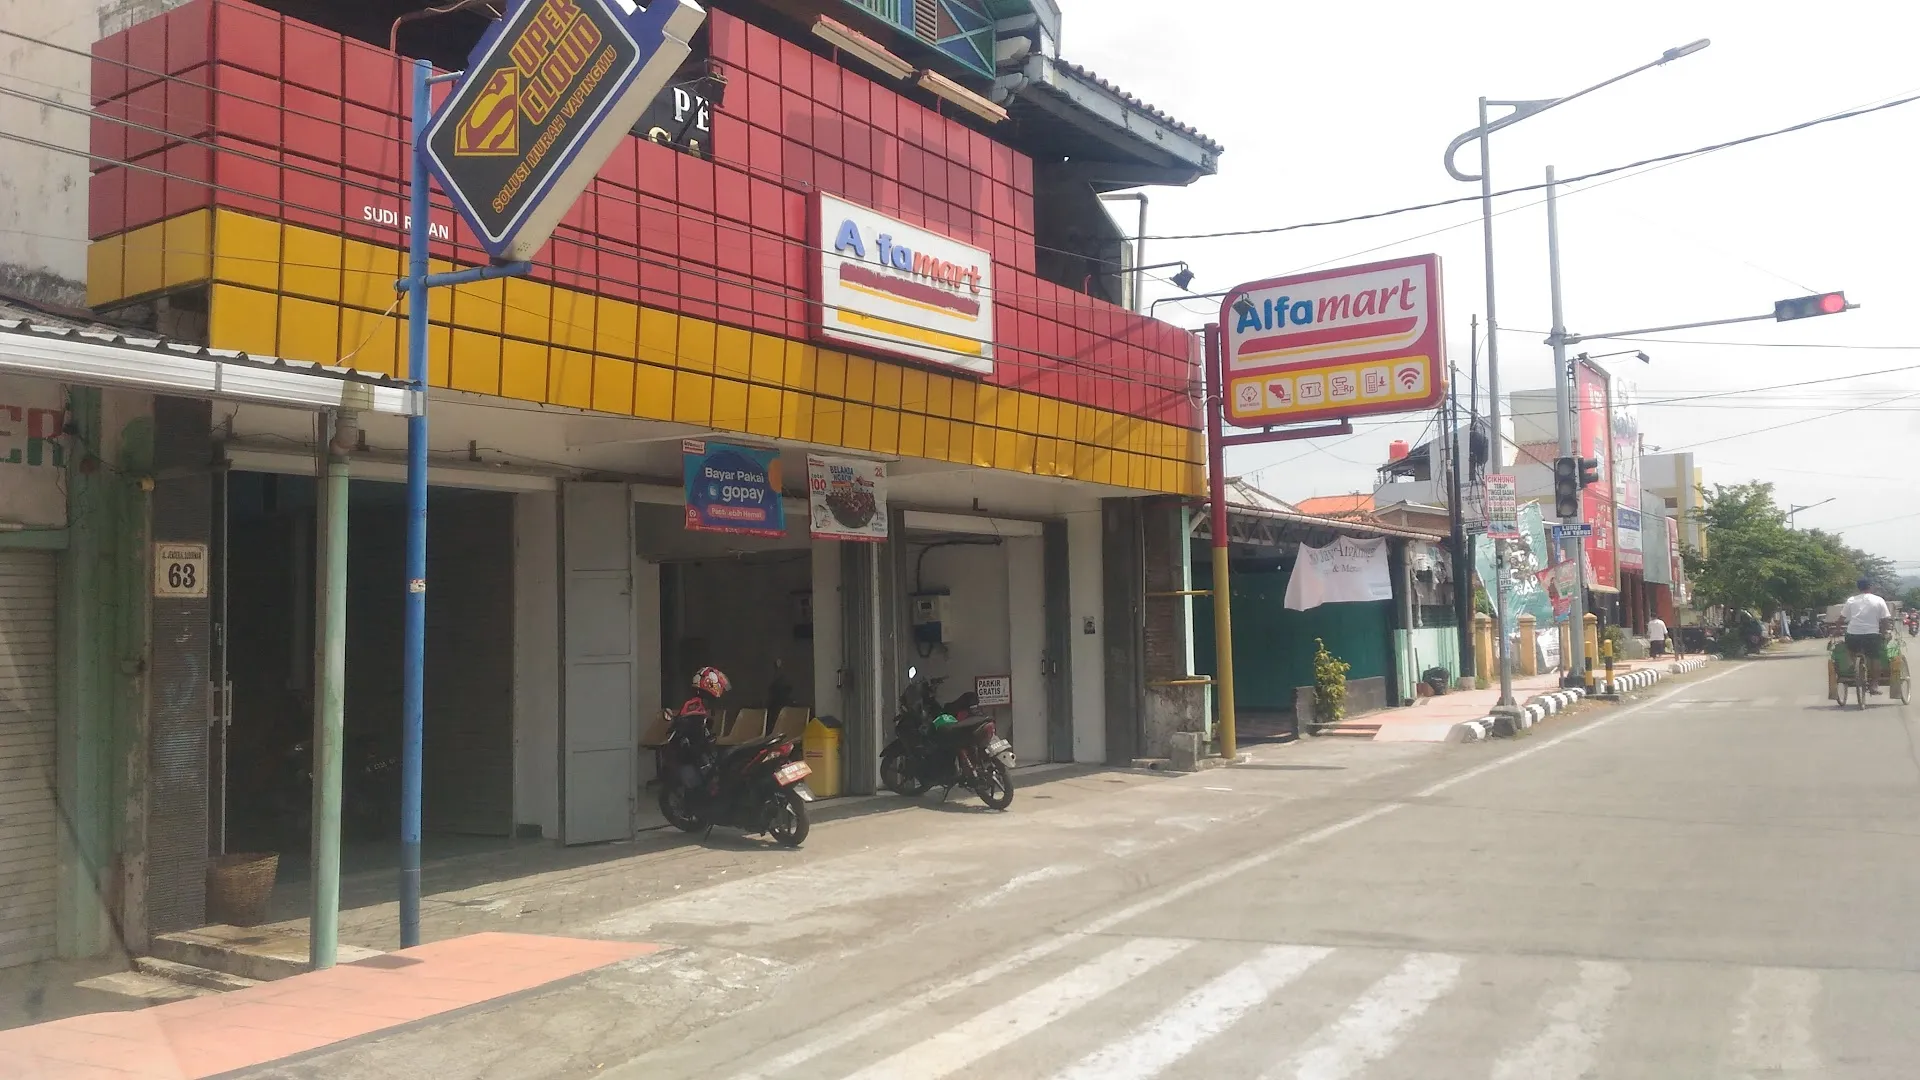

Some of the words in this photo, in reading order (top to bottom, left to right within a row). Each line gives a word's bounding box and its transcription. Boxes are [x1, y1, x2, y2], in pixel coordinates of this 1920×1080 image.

[518, 12, 603, 126] CLOUD
[492, 161, 531, 214] SOLUSI
[526, 114, 567, 173] MURAH
[561, 44, 618, 119] VAPINGMU
[1236, 278, 1417, 335] Alfamart
[705, 467, 736, 482] Bayar
[737, 471, 764, 483] Pakai
[810, 478, 827, 490] 100
[722, 485, 765, 503] gopay
[169, 563, 196, 588] 63
[978, 680, 1001, 688] PARKIR
[978, 687, 1001, 695] GRATIS
